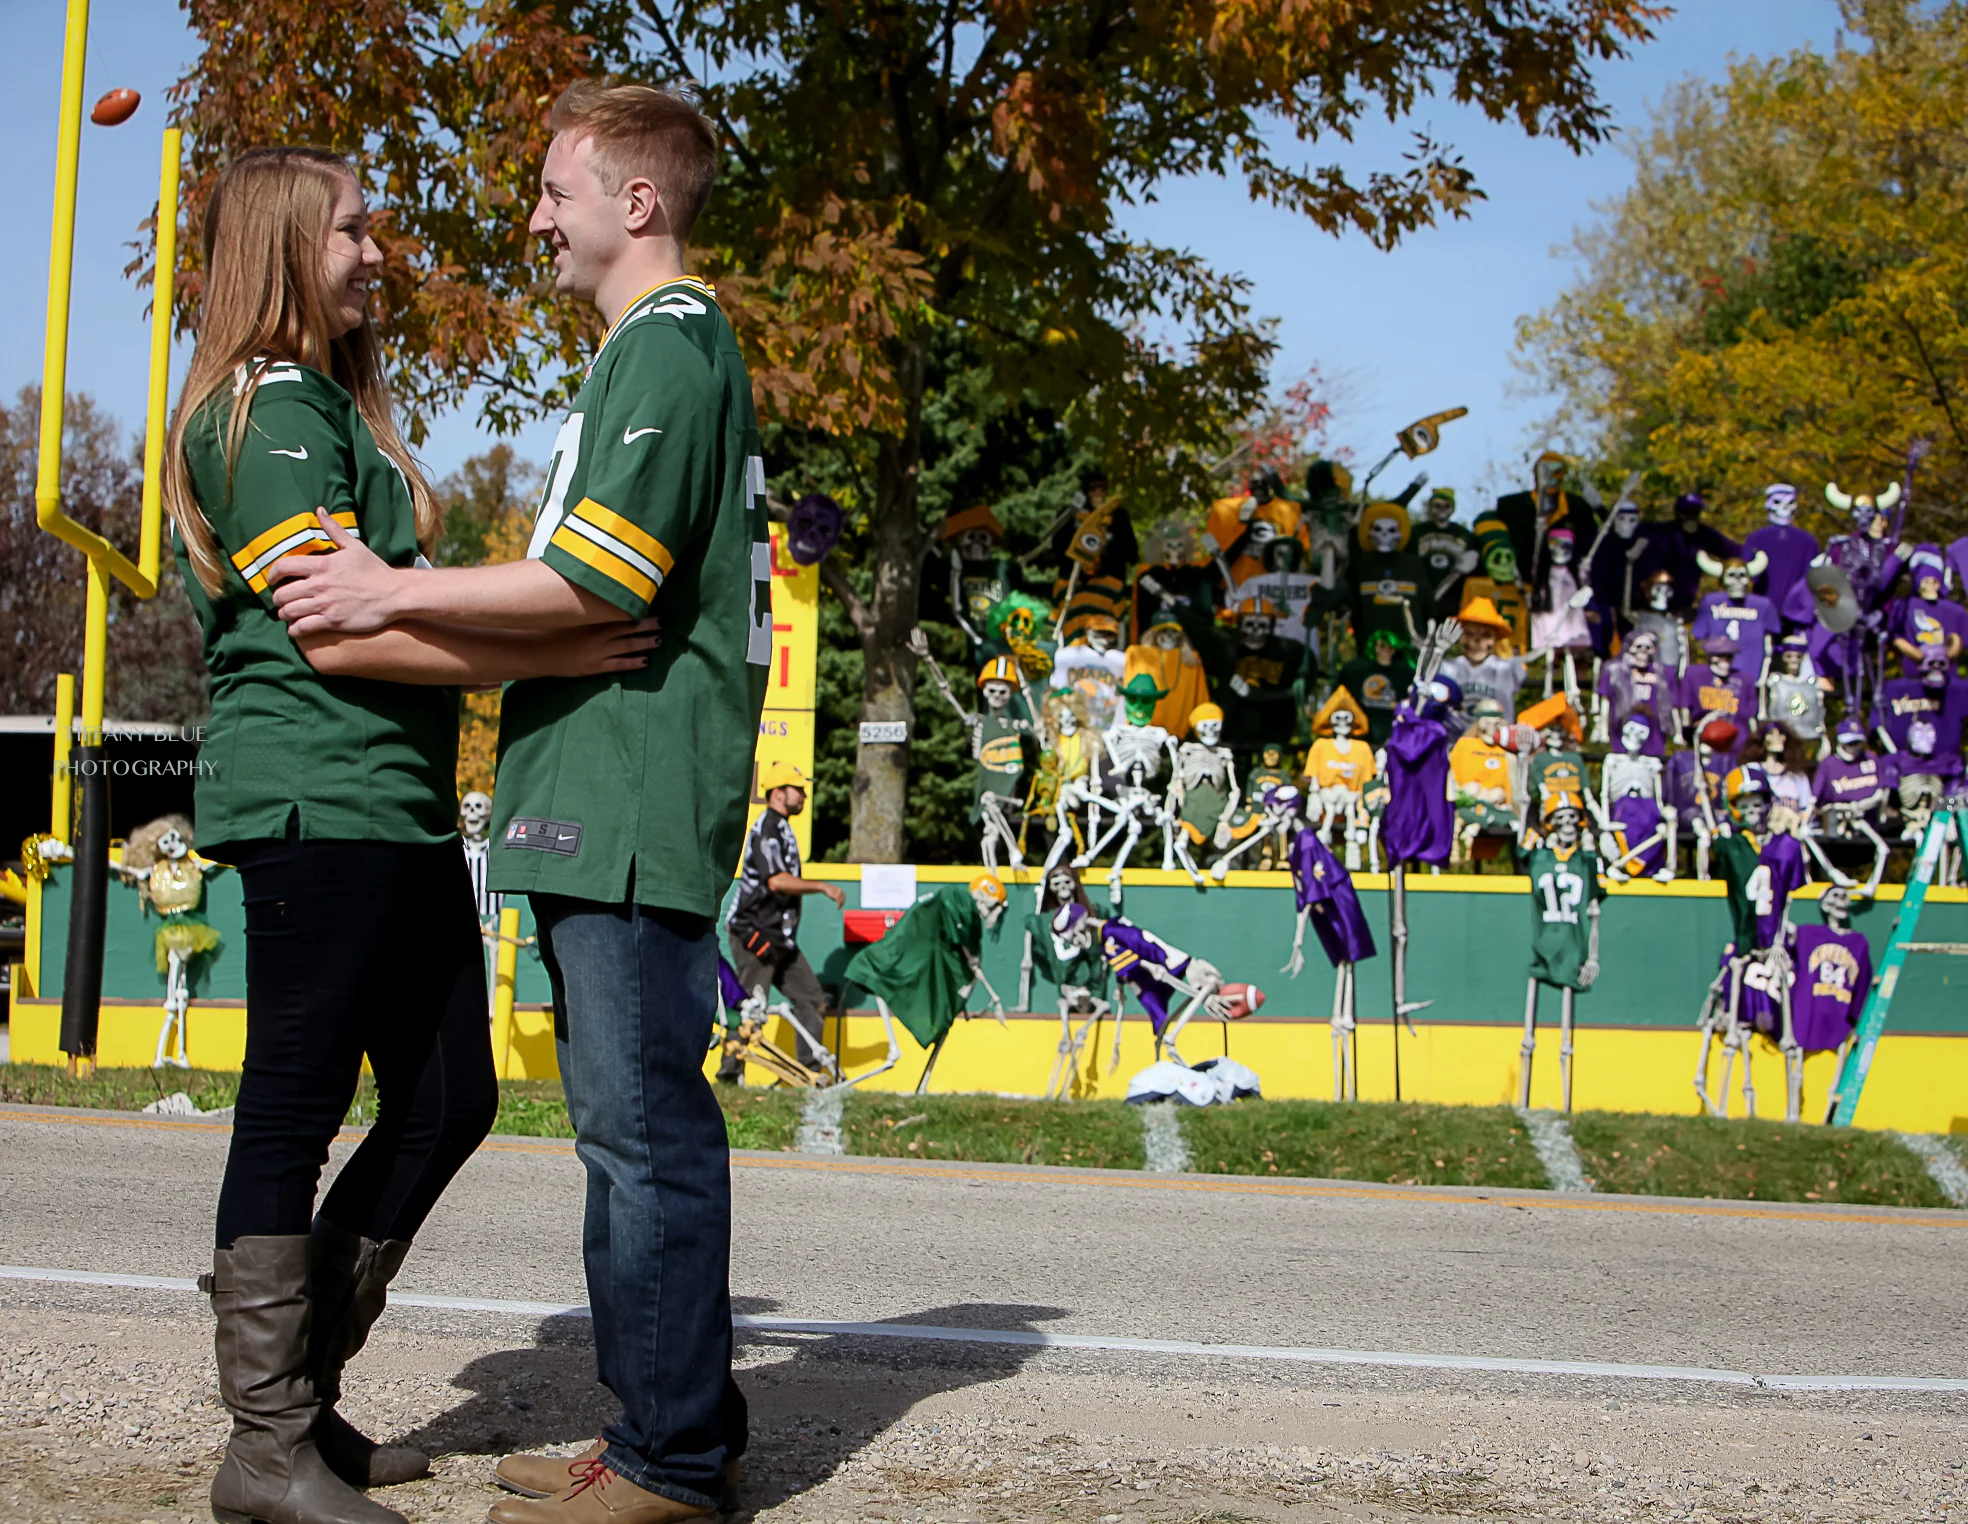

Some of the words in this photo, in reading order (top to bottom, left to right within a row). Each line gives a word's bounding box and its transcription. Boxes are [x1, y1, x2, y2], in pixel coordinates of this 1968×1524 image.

[538, 823, 549, 835] S
[1537, 872, 1584, 925] 12
[1745, 865, 1774, 916] 4
